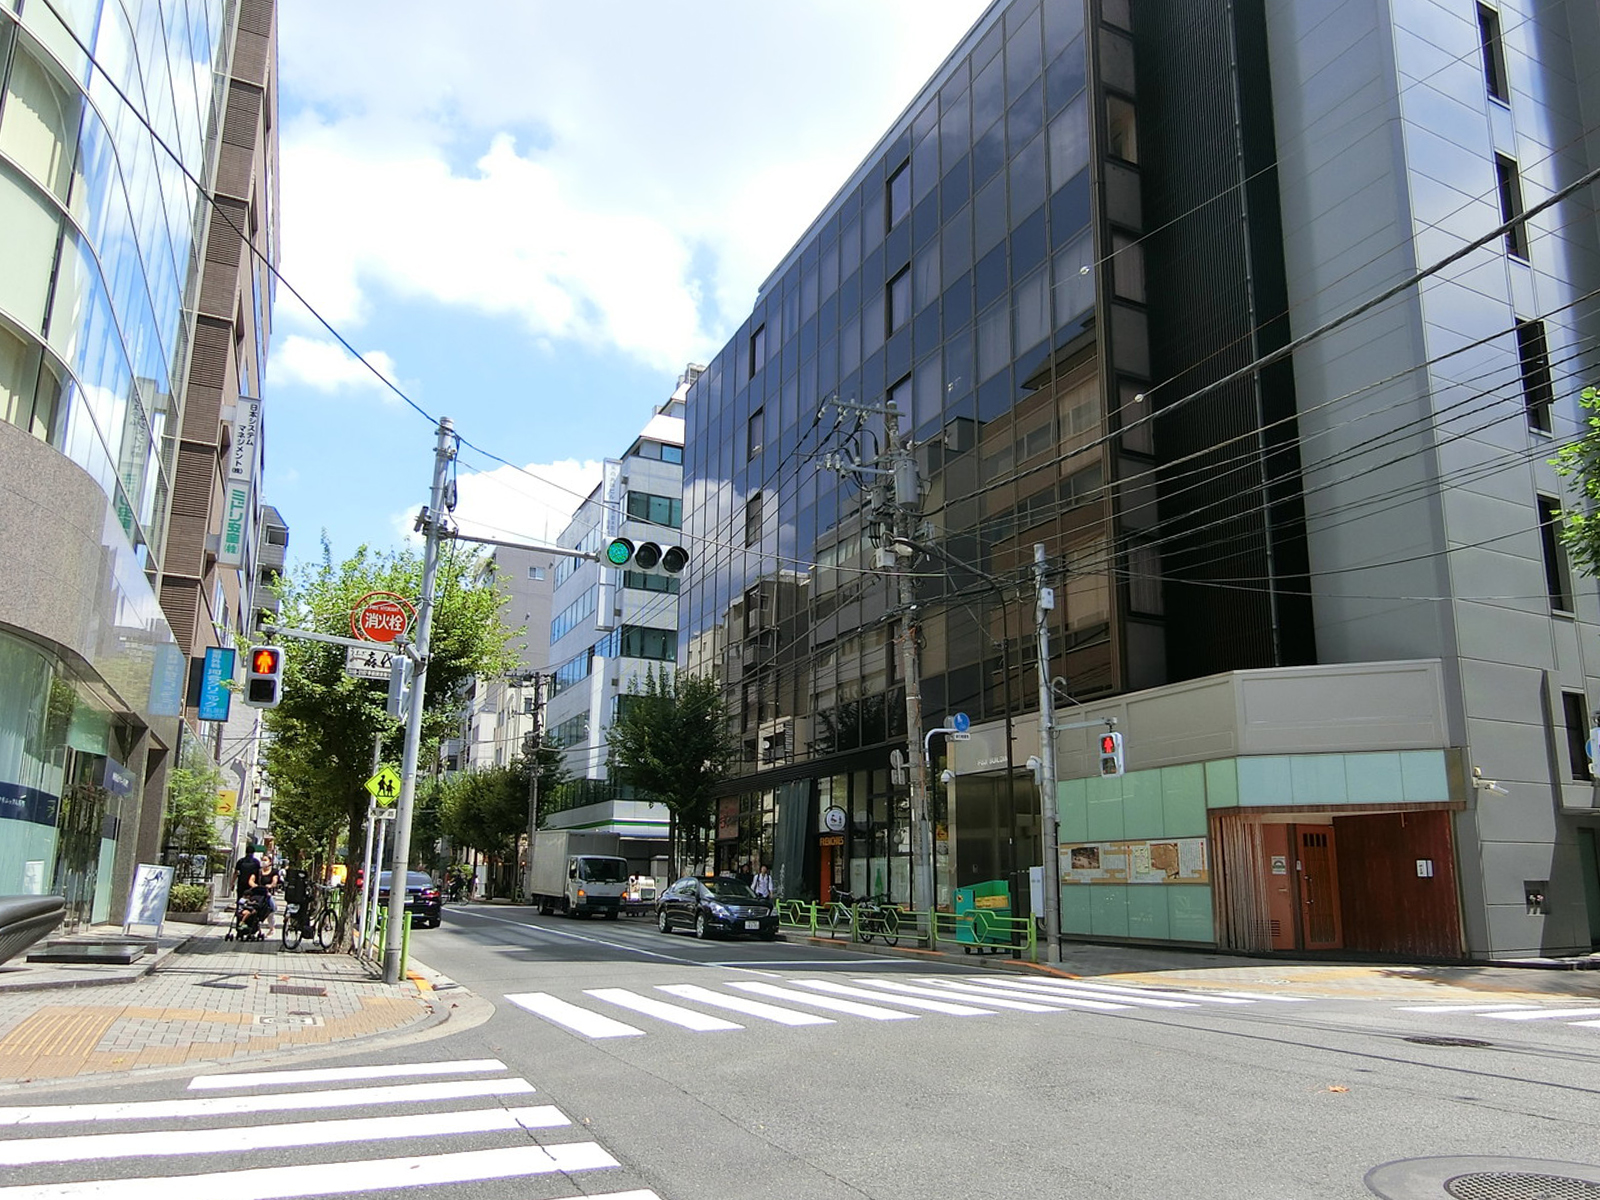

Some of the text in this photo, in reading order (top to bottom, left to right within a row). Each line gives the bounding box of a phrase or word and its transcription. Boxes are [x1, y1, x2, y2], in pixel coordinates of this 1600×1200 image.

[246, 404, 258, 446] 日本システム
[365, 612, 403, 631] 消火栓
